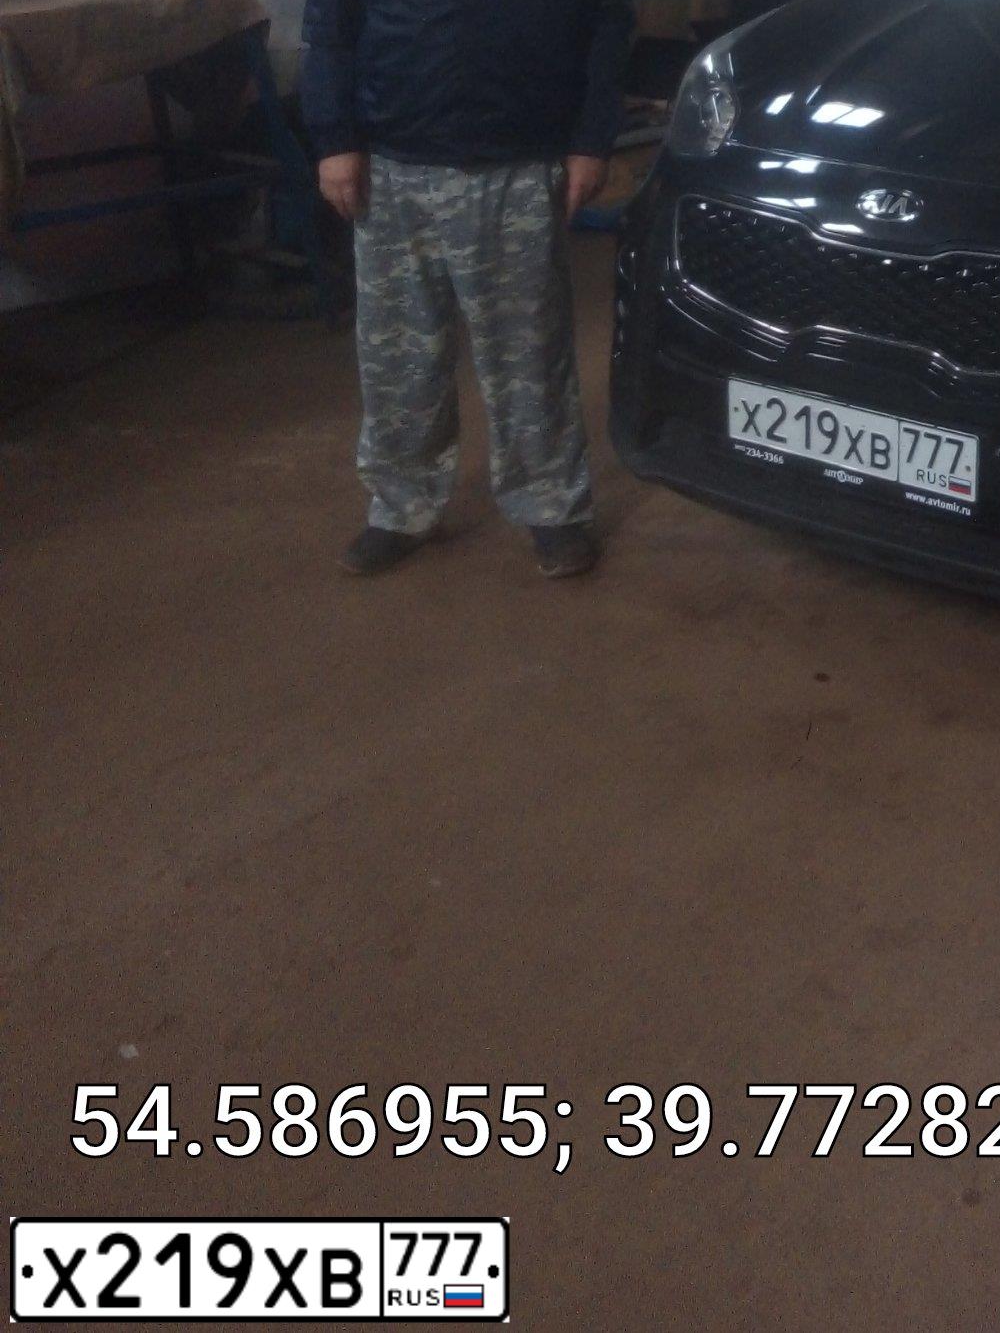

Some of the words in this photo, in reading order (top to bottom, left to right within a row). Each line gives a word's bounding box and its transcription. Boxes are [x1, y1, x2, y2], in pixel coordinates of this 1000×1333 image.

[741, 397, 892, 471] Х219ХВ
[903, 427, 964, 474] 777
[916, 469, 947, 488] RUS
[905, 491, 971, 516] www.avtomir.ru
